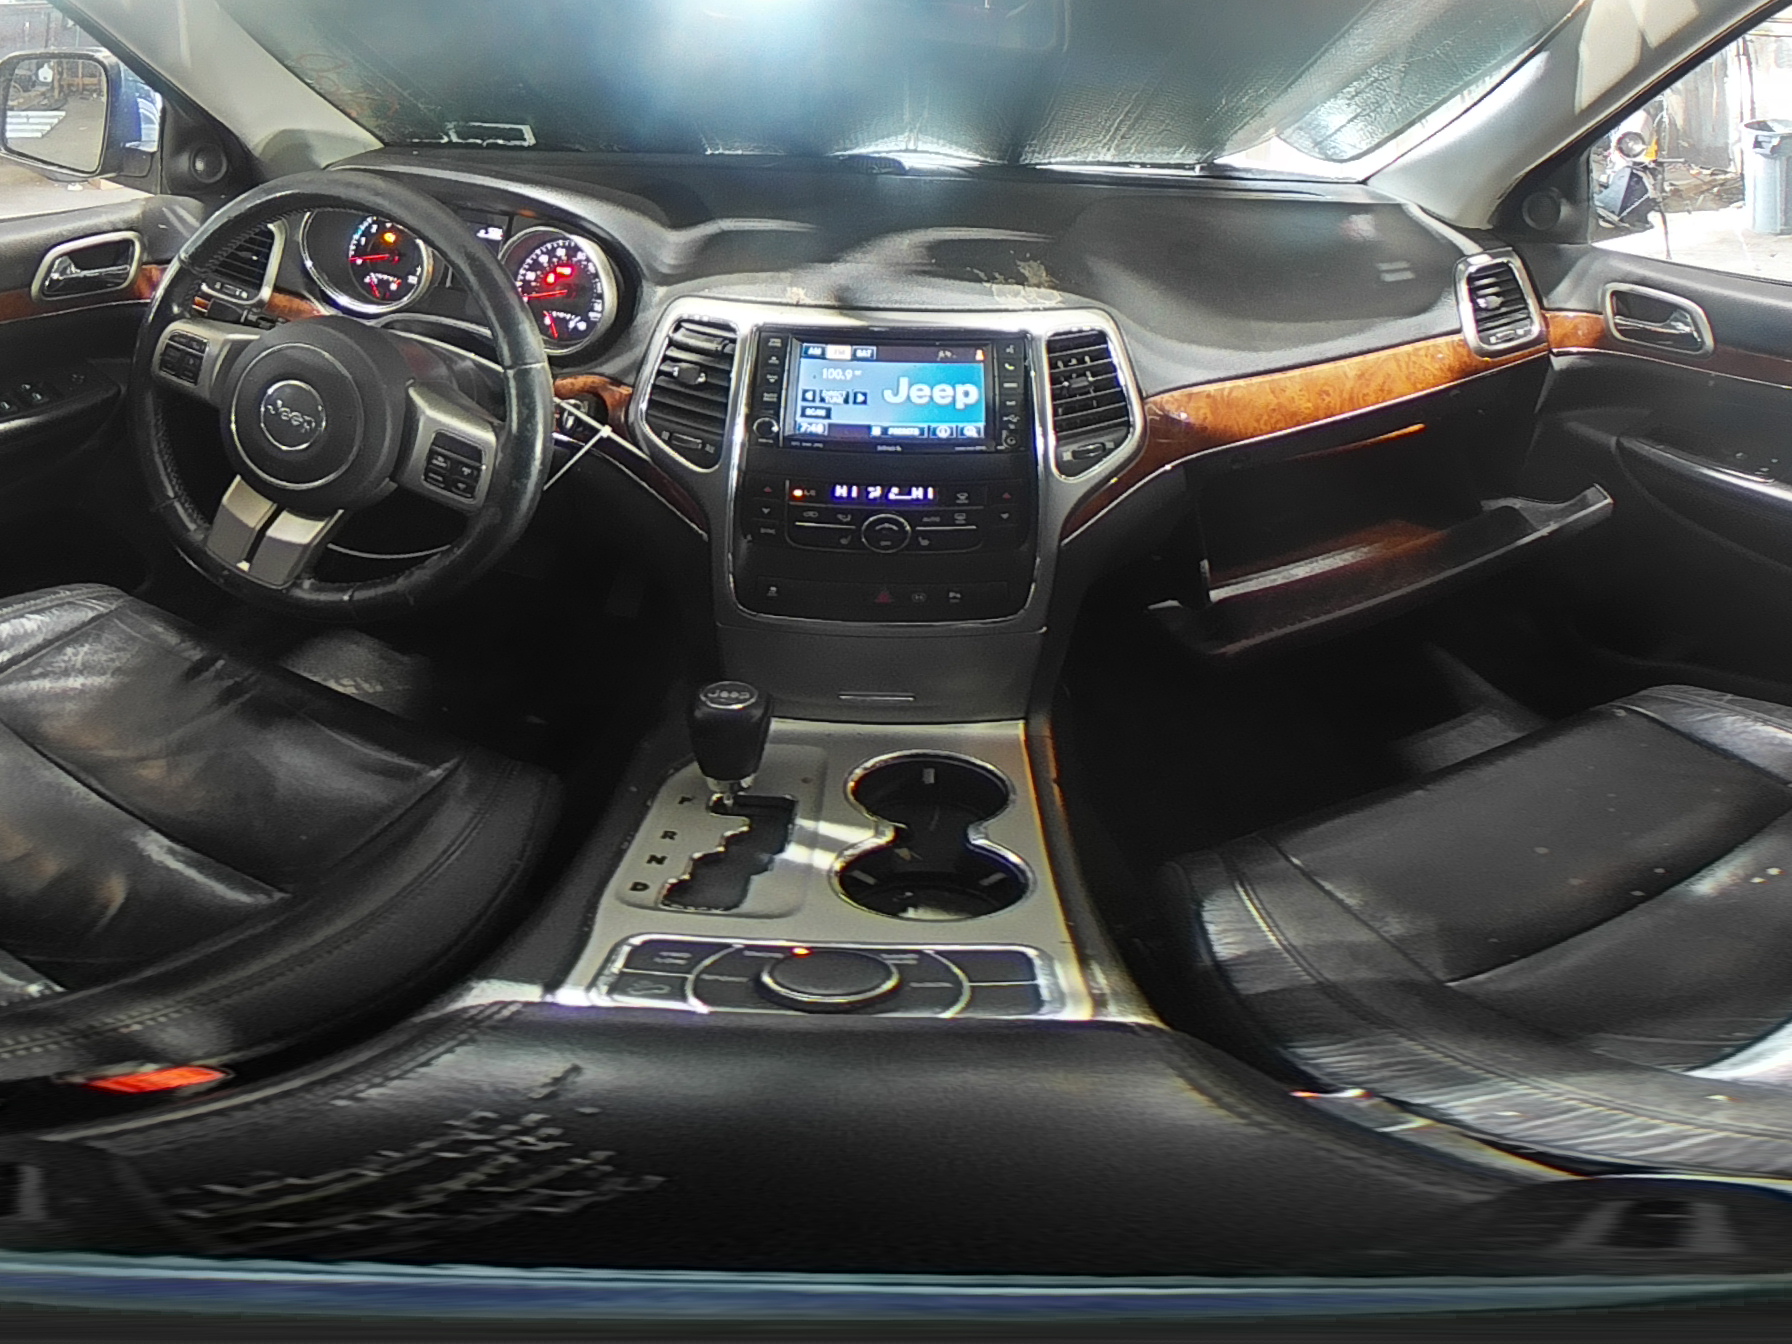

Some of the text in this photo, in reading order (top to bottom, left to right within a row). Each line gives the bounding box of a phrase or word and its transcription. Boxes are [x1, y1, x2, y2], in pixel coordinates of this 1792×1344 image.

[822, 367, 853, 380] 100.9
[883, 376, 980, 410] Jeep
[266, 399, 316, 433] Jeep
[660, 830, 678, 840] R
[646, 854, 667, 865] N
[629, 881, 650, 892] D
